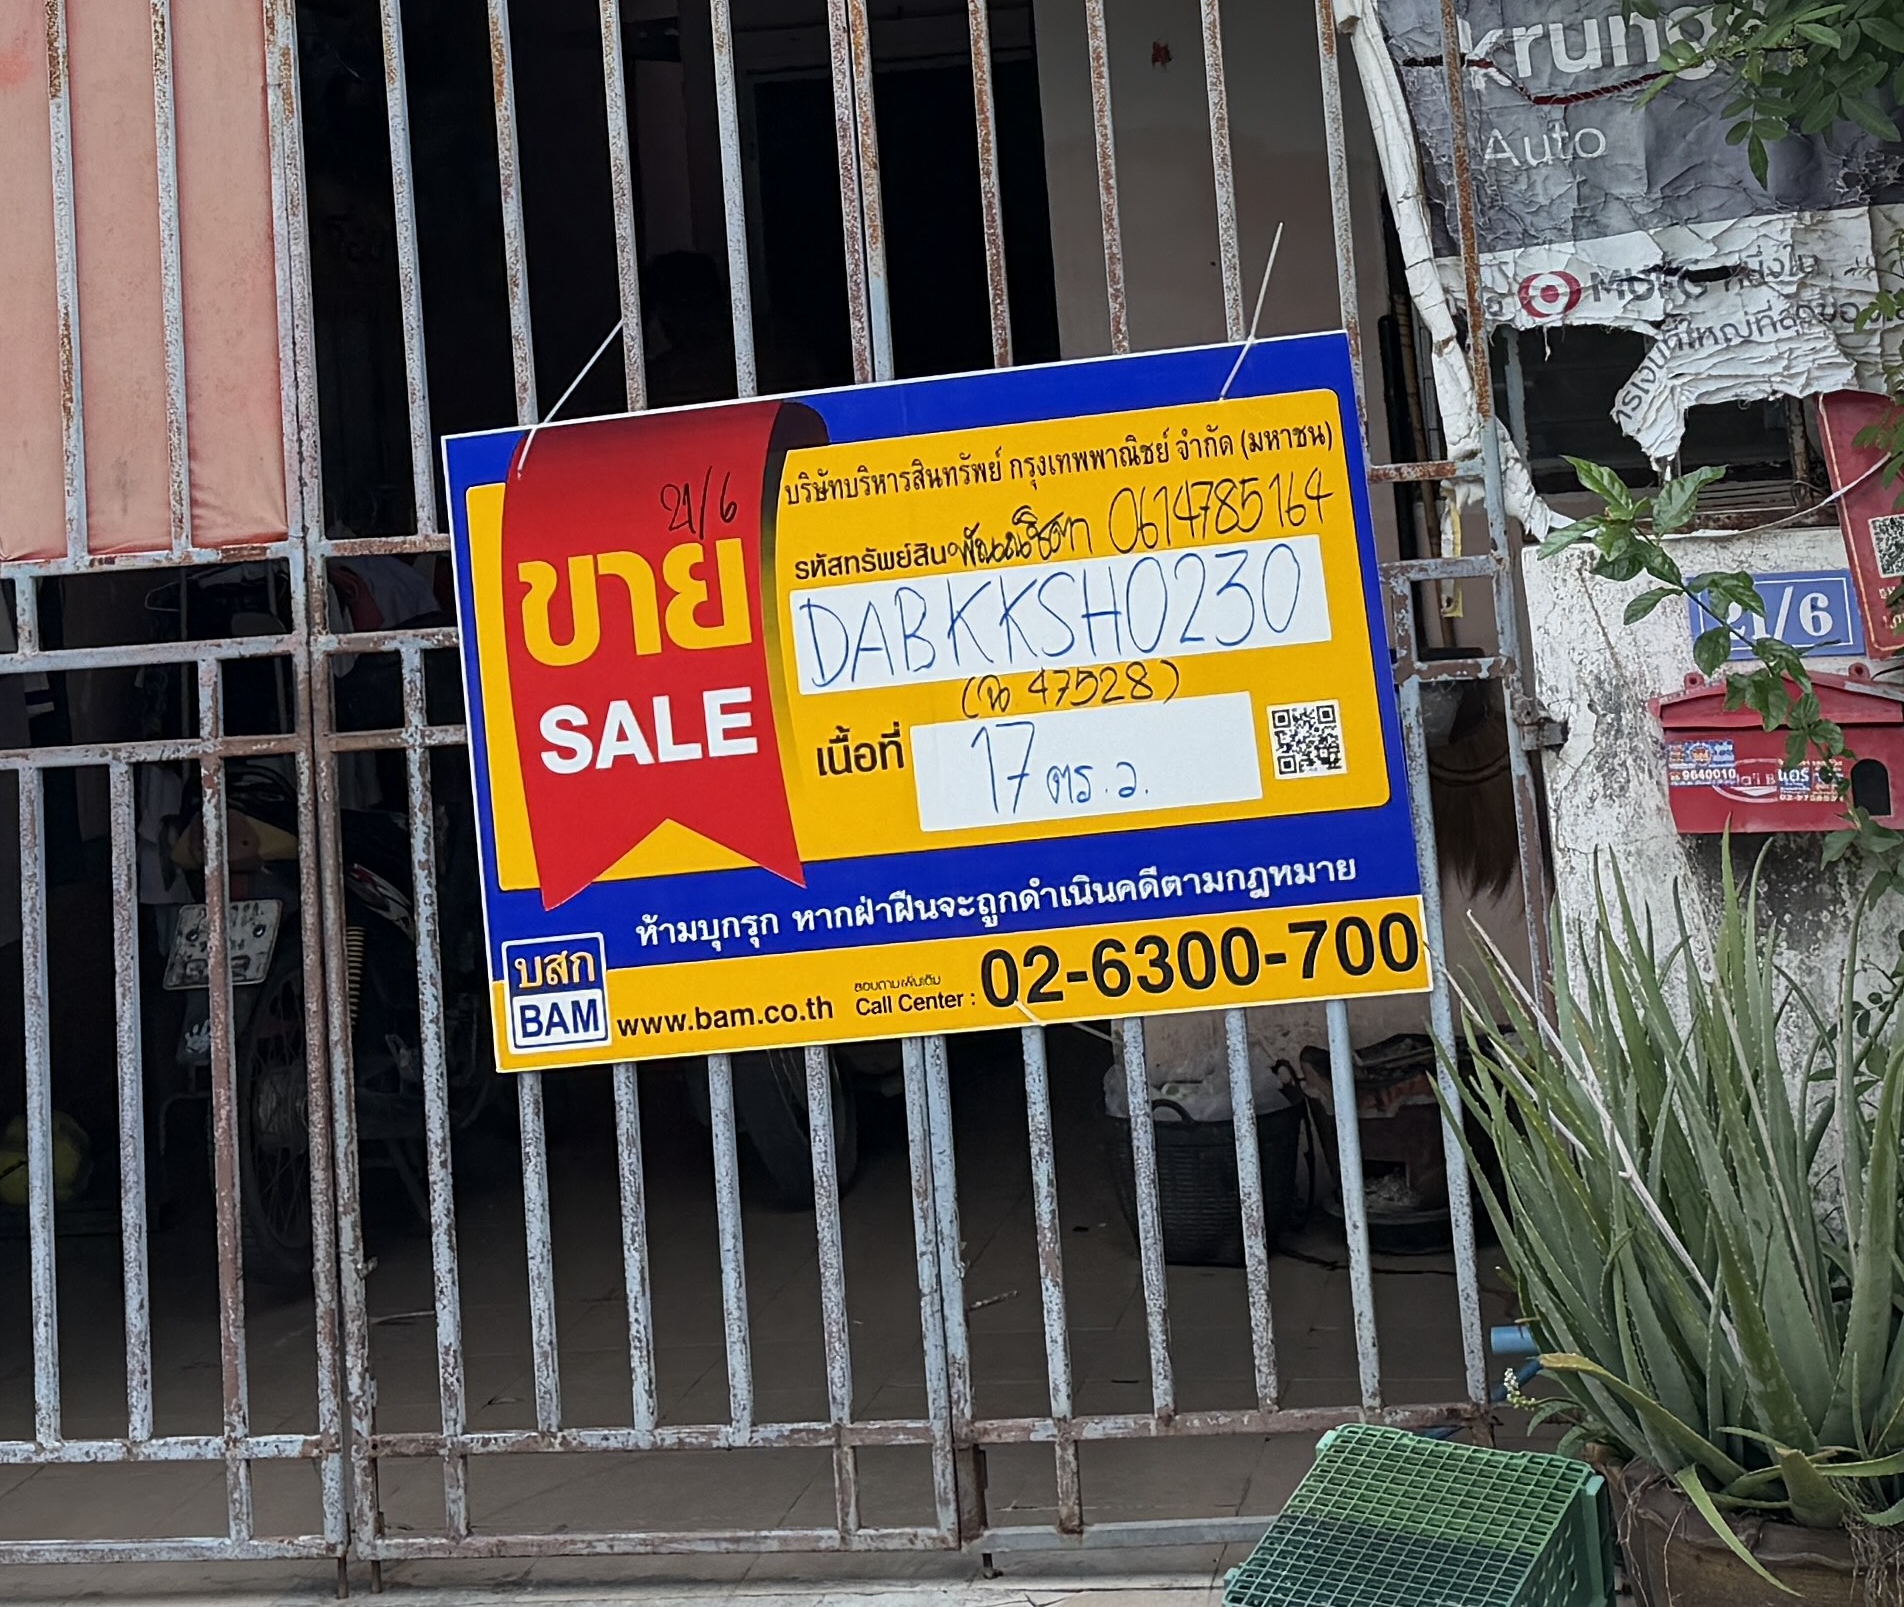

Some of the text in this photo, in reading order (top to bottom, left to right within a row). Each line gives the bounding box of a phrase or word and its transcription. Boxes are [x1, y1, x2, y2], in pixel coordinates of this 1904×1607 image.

[1484, 123, 1607, 168] Auto
[785, 420, 1334, 507] บริษัทบริหารสินทรัพย์ กรุงเทพพาณิชย์ จำกัด (มหาชน)
[517, 537, 753, 666] ขาย
[539, 686, 758, 775] SALE
[816, 721, 906, 777] เนื้อที่
[970, 720, 1036, 814] 17
[635, 855, 1357, 952] ห้ามบุกรุก หากฝ่าฝืนจะถูกดำเนินคดีตามกฎหมาย
[514, 947, 596, 989] บสก
[980, 912, 1421, 1008] 02-6300-700
[520, 997, 600, 1038] BAM
[617, 996, 834, 1037] www.bam.co.th
[856, 995, 892, 1016] Call
[898, 992, 964, 1012] Center
